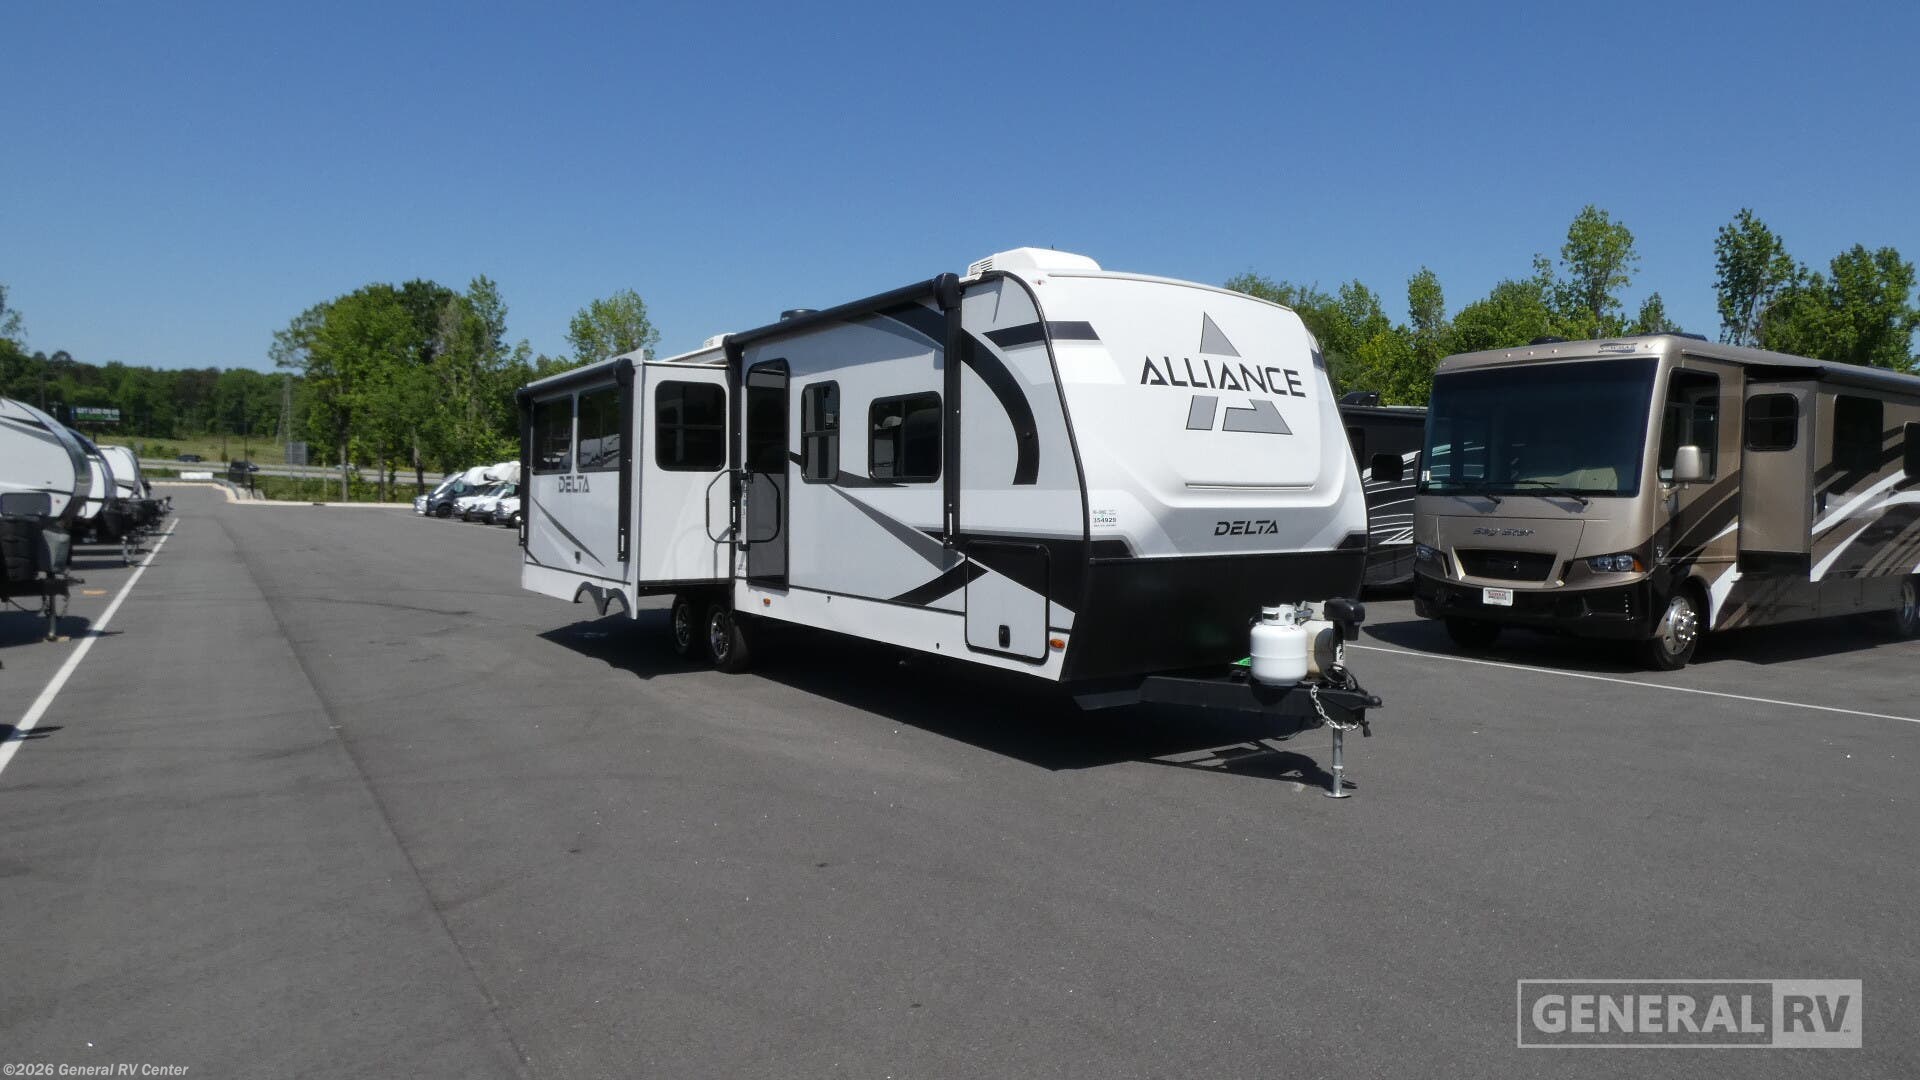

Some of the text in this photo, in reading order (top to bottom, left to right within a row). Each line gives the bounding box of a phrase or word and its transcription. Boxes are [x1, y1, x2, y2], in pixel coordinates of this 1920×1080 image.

[1140, 355, 1307, 398] ALLIANCE
[558, 474, 591, 493] DELTA
[1214, 520, 1279, 536] DELTA
